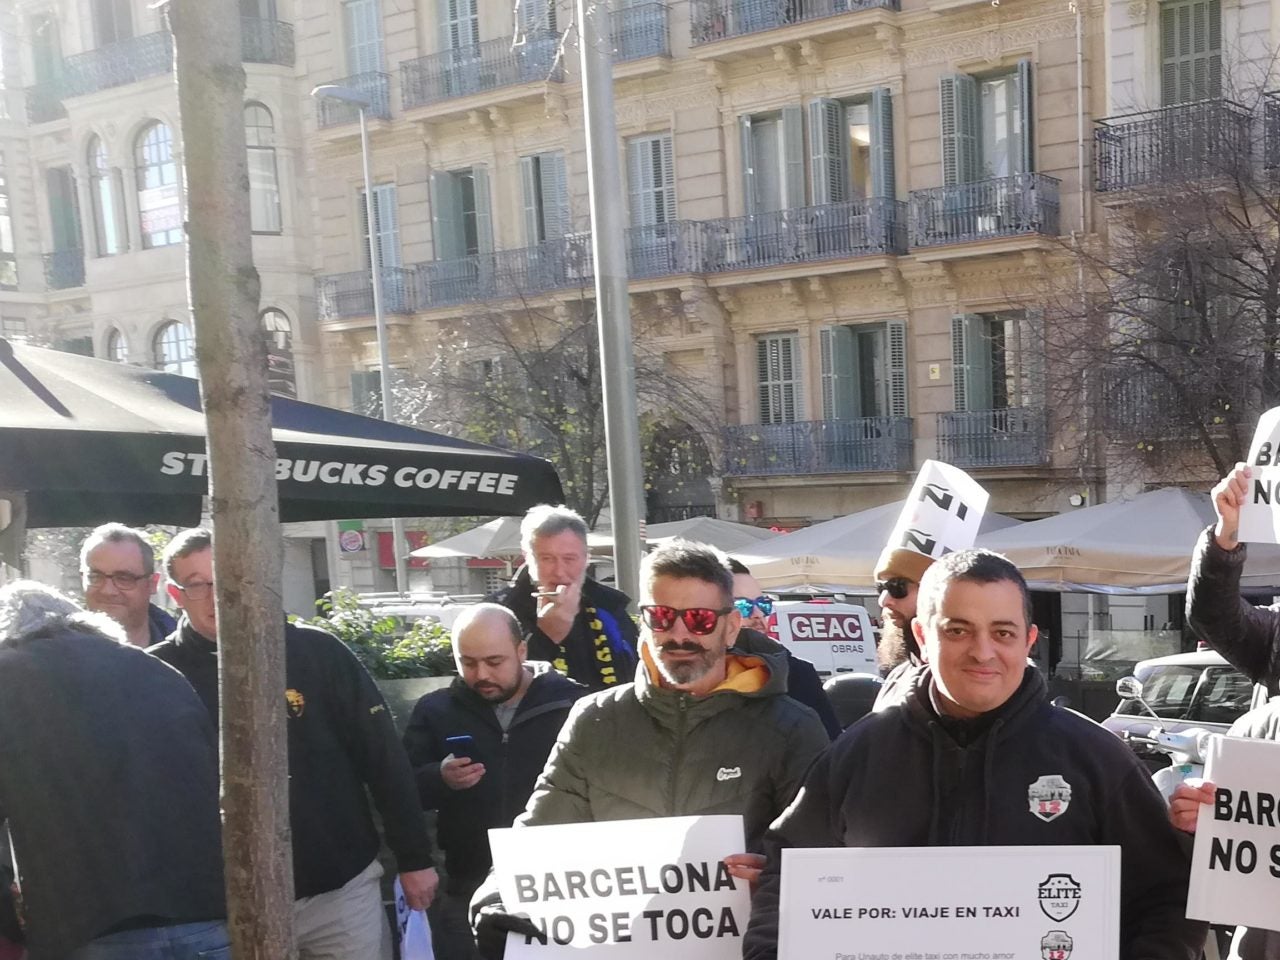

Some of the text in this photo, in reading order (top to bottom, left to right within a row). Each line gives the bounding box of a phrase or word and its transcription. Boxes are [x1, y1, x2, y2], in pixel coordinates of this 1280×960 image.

[160, 452, 519, 495] STBUCKS COFFEE
[791, 616, 862, 639] GEAC
[831, 644, 864, 654] OBRAS
[1038, 800, 1062, 814] 12
[1209, 837, 1257, 874] NO
[514, 861, 737, 903] BARCELONA
[1038, 888, 1081, 899] ELITE
[811, 906, 1020, 919] VALE POR: VIAJE EN TAXI
[588, 912, 632, 944] SE
[642, 907, 740, 941] TOCA
[835, 952, 856, 960] Para
[891, 952, 903, 960] de
[904, 951, 923, 960] elite
[925, 951, 940, 960] taxi
[960, 951, 990, 960] mucho
[992, 952, 1016, 960] amor
[1049, 950, 1065, 960] 12
